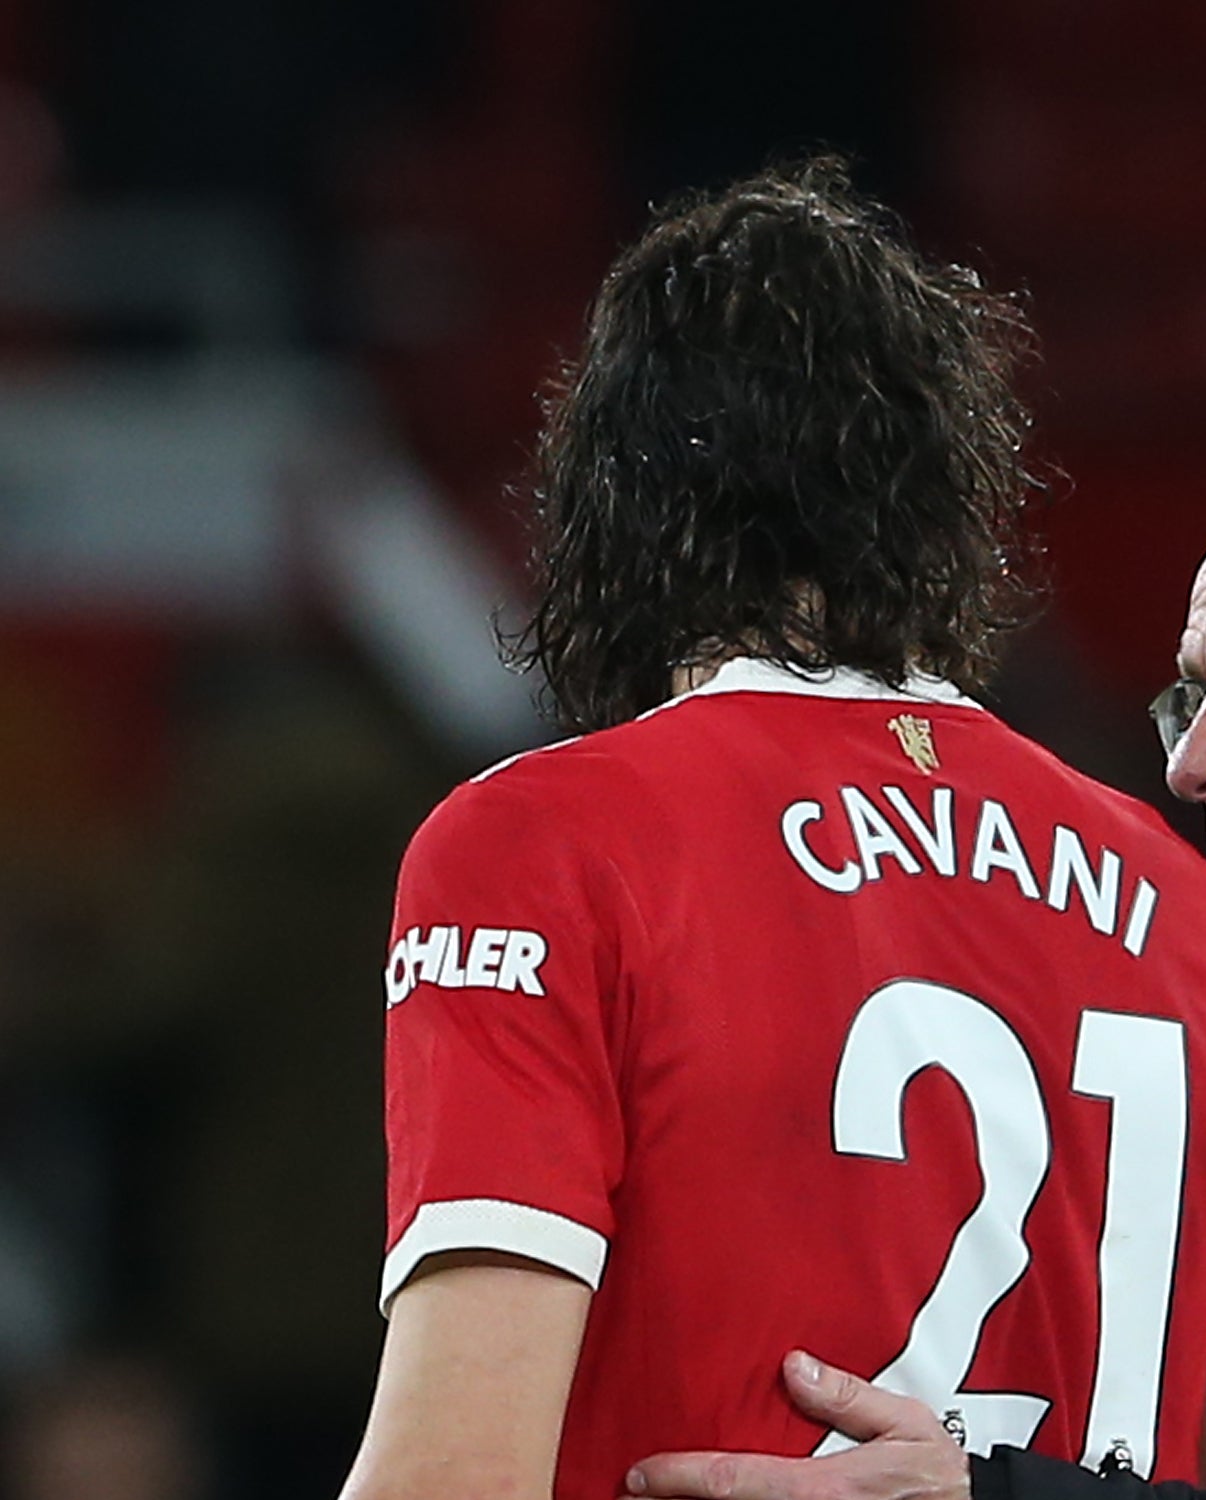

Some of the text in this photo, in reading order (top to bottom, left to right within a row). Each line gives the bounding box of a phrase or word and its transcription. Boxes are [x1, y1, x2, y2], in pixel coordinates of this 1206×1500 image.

[781, 786, 1158, 957] CAVANI
[384, 925, 548, 1009] OHLER
[813, 978, 1189, 1481] 21
